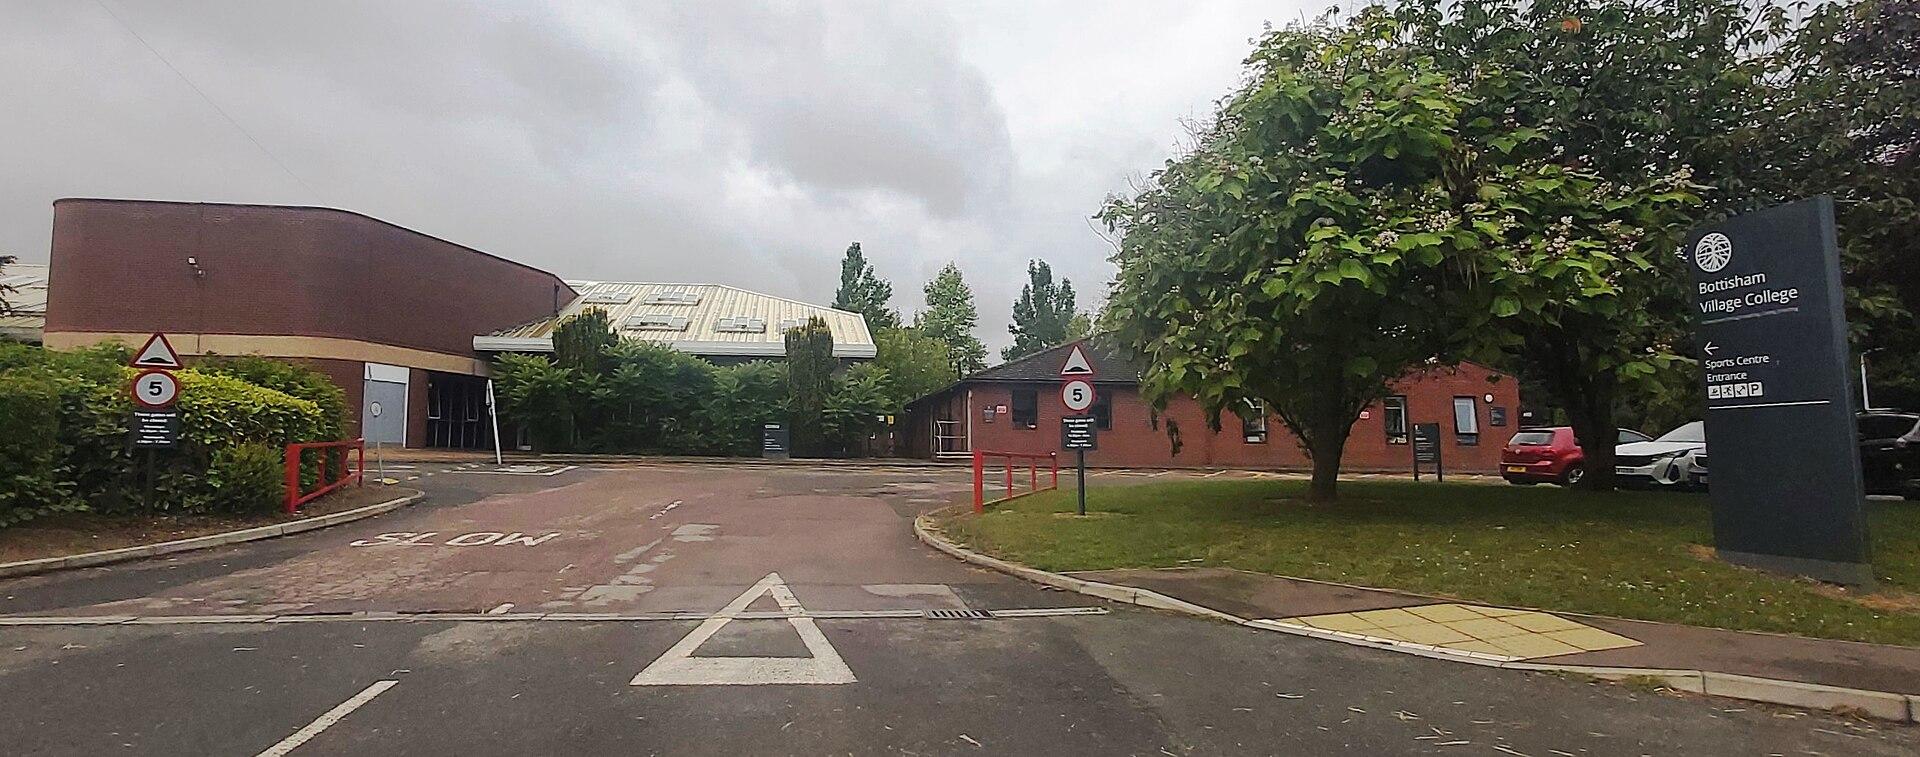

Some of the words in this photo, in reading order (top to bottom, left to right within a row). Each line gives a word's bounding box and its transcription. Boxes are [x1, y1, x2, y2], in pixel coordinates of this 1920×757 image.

[1699, 273, 1766, 294] Bottisham
[1699, 298, 1742, 313] Village
[1745, 288, 1798, 304] College
[1705, 359, 1735, 369] Sports
[1736, 355, 1770, 365] Centre
[1706, 372, 1748, 382] Entrance
[149, 381, 163, 396] 5
[1072, 388, 1083, 402] 5
[1751, 384, 1760, 394] P
[350, 532, 561, 546] SLOW
